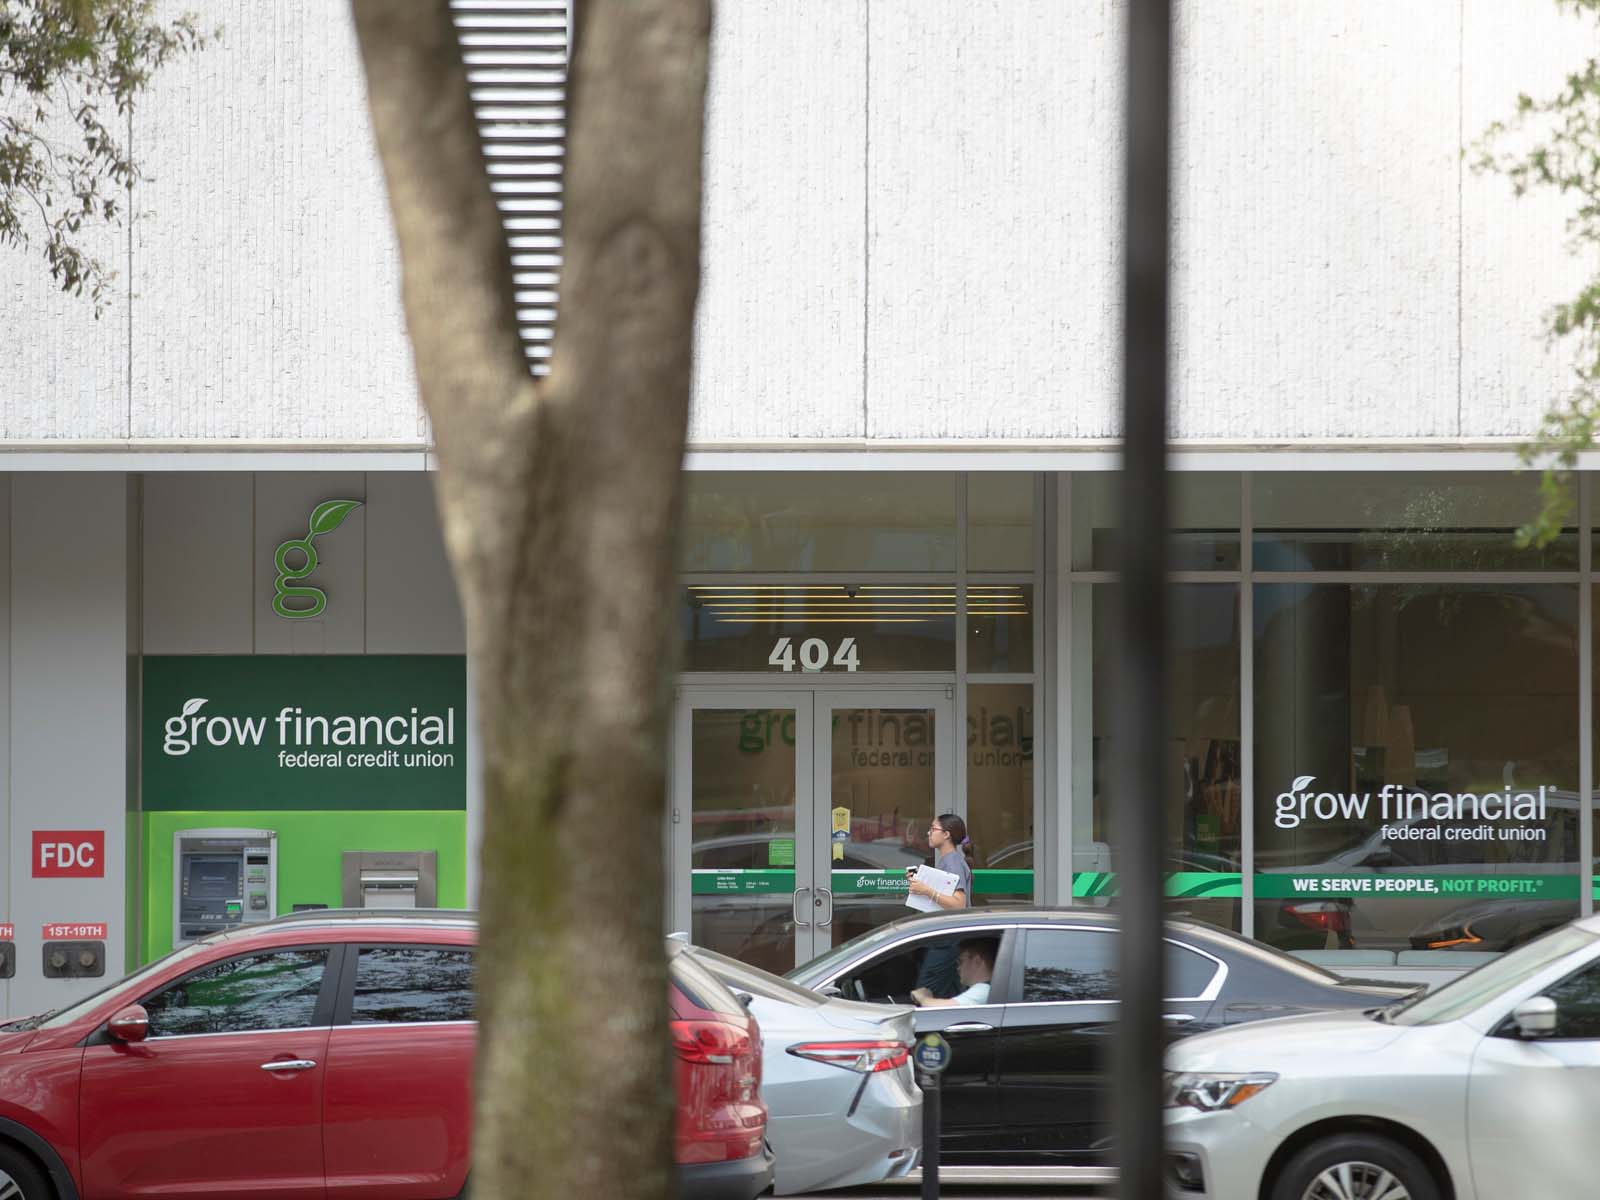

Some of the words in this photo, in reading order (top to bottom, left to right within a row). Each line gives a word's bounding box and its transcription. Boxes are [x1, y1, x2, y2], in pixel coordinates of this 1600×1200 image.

[768, 637, 860, 672] 404
[163, 698, 267, 756] grow
[275, 707, 454, 746] financial
[278, 751, 342, 767] federal
[347, 751, 400, 767] credit
[404, 752, 454, 767] union
[1274, 776, 1370, 829] grow
[1381, 825, 1441, 841] federal
[1444, 825, 1495, 841] credit
[1499, 826, 1546, 841] union
[40, 842, 95, 868] FDC
[856, 876, 876, 888] grow
[1293, 879, 1318, 892] WE
[1321, 879, 1371, 892] SERVE
[1375, 879, 1439, 894] PEOPLE,
[1442, 879, 1474, 893] NOT
[48, 926, 102, 936] 1ST-19TH
